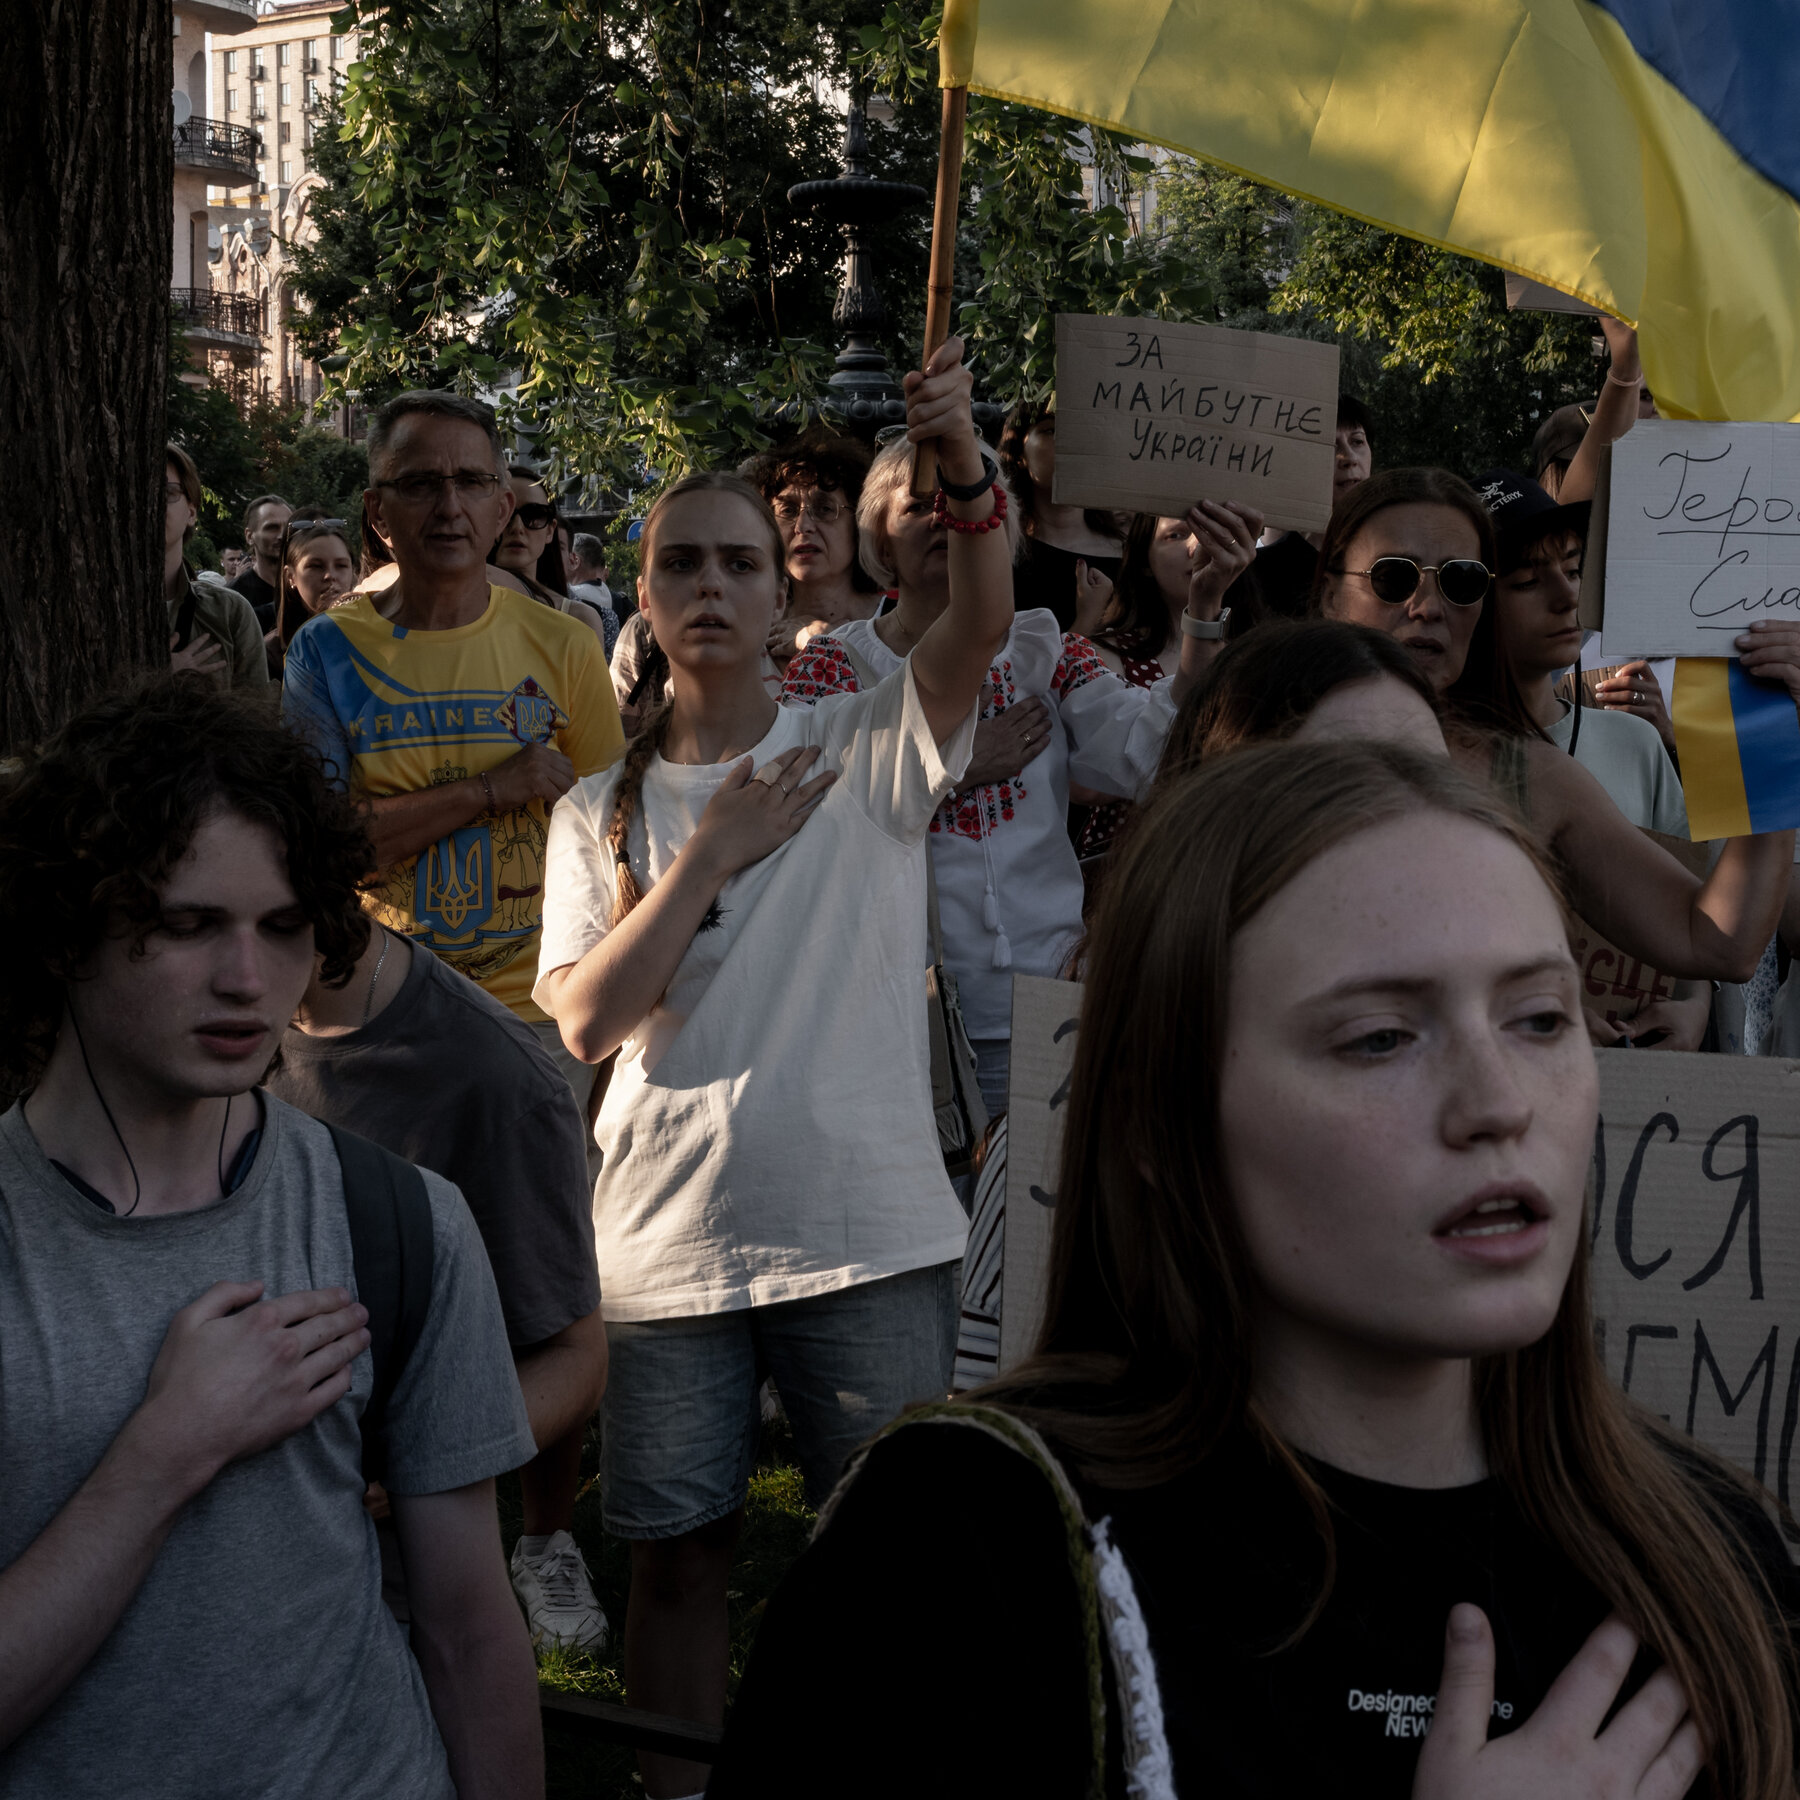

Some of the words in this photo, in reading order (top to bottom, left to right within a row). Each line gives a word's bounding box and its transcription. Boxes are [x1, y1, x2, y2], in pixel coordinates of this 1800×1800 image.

[1115, 332, 1163, 370] ЗА
[1092, 379, 1322, 435] МАЙБУТНЄ
[1643, 442, 1800, 558] Геро
[348, 706, 493, 738] KRAINE
[1592, 1111, 1764, 1300] СЯ
